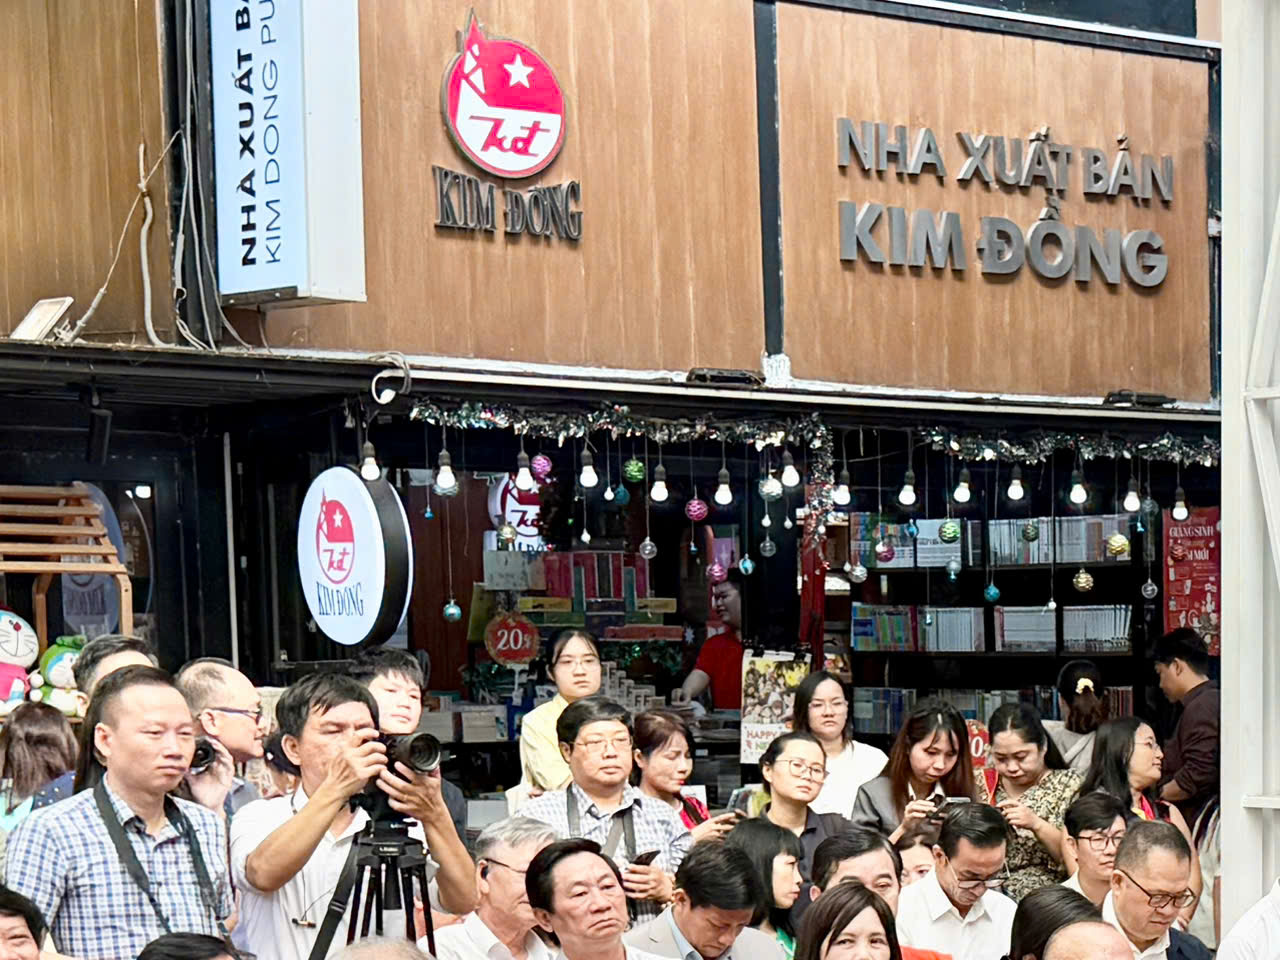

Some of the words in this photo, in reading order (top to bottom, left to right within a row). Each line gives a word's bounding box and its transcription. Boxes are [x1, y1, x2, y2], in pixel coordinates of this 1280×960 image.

[235, 0, 251, 31] B
[231, 49, 255, 159] XUẤT
[262, 59, 281, 184] DONG
[432, 165, 497, 232] KIM
[956, 126, 1072, 192] XUẤT
[1083, 132, 1174, 203] BẢN
[236, 168, 257, 266] NHÀ
[265, 199, 281, 264] KIM
[838, 200, 967, 272] KIM
[977, 196, 1169, 288] ĐỒNG
